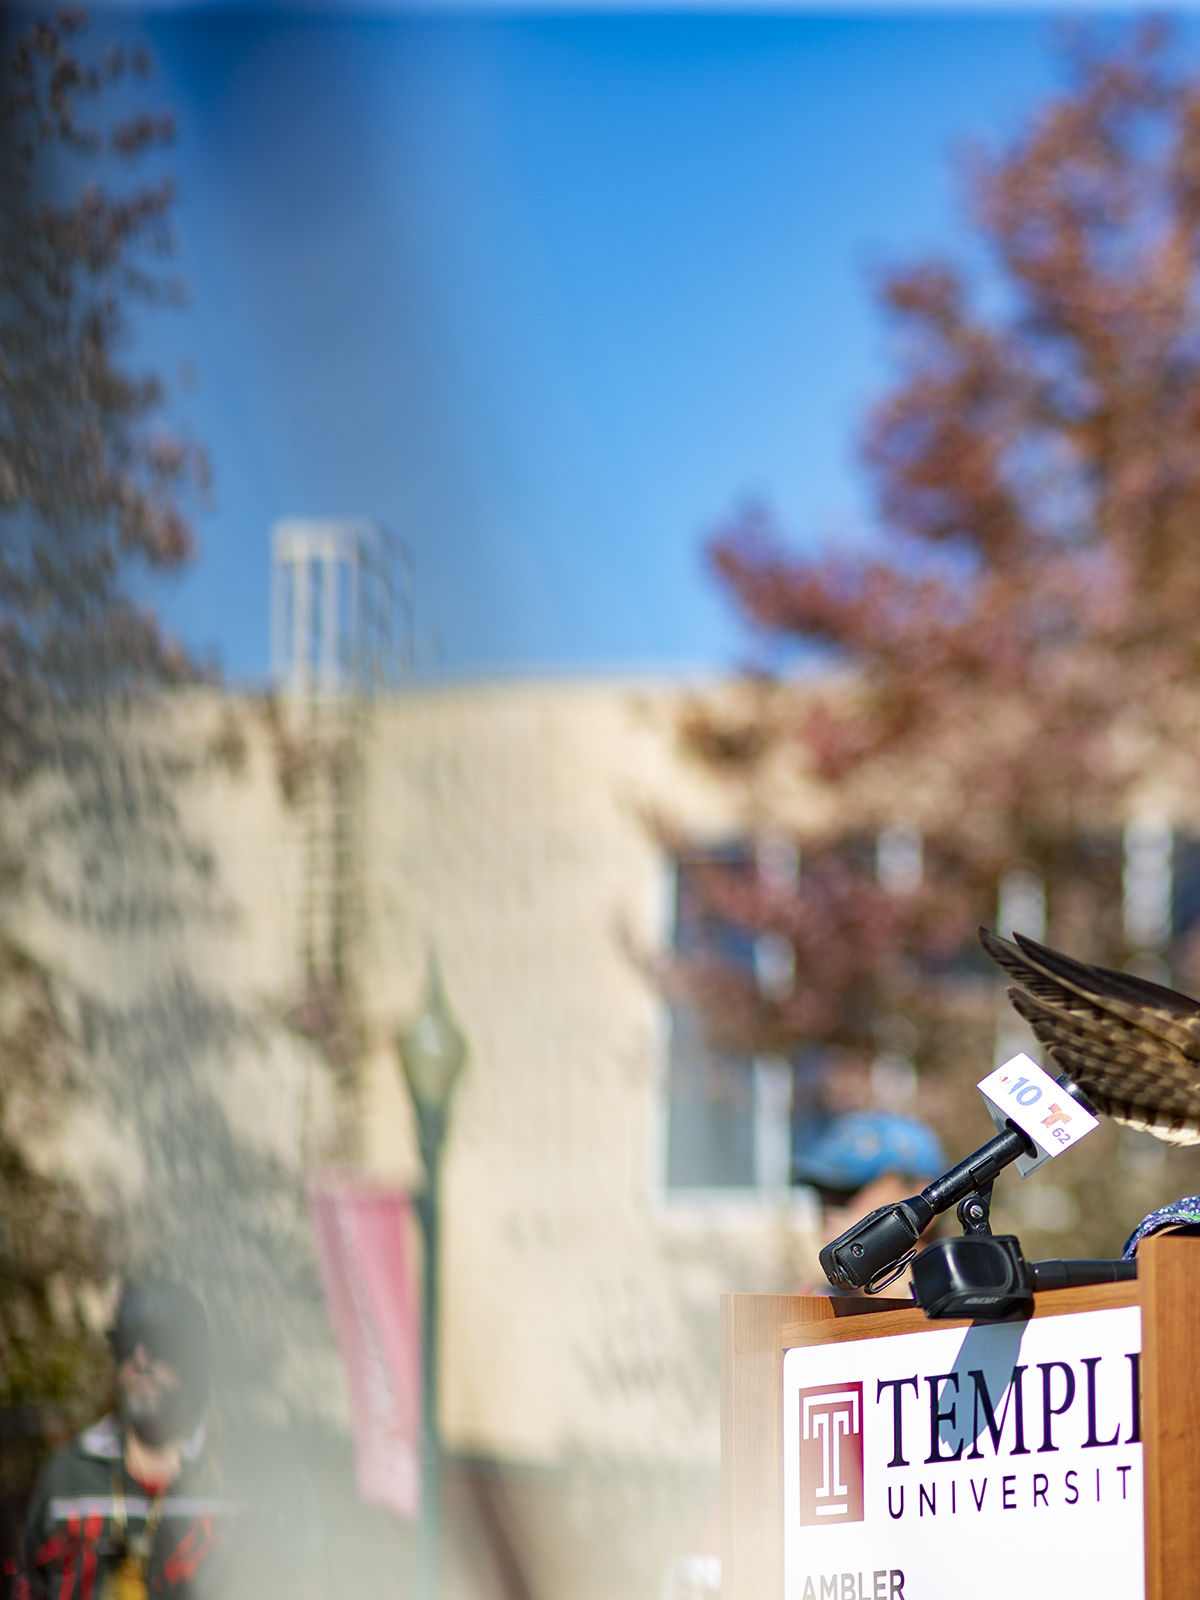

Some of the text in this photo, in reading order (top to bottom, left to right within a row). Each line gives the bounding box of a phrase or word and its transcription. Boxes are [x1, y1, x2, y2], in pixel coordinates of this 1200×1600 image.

[1008, 1076, 1043, 1106] 10
[1052, 1127, 1071, 1145] 62
[887, 1465, 1132, 1519] UNIVERSIT
[802, 1569, 905, 1600] AMBLER
